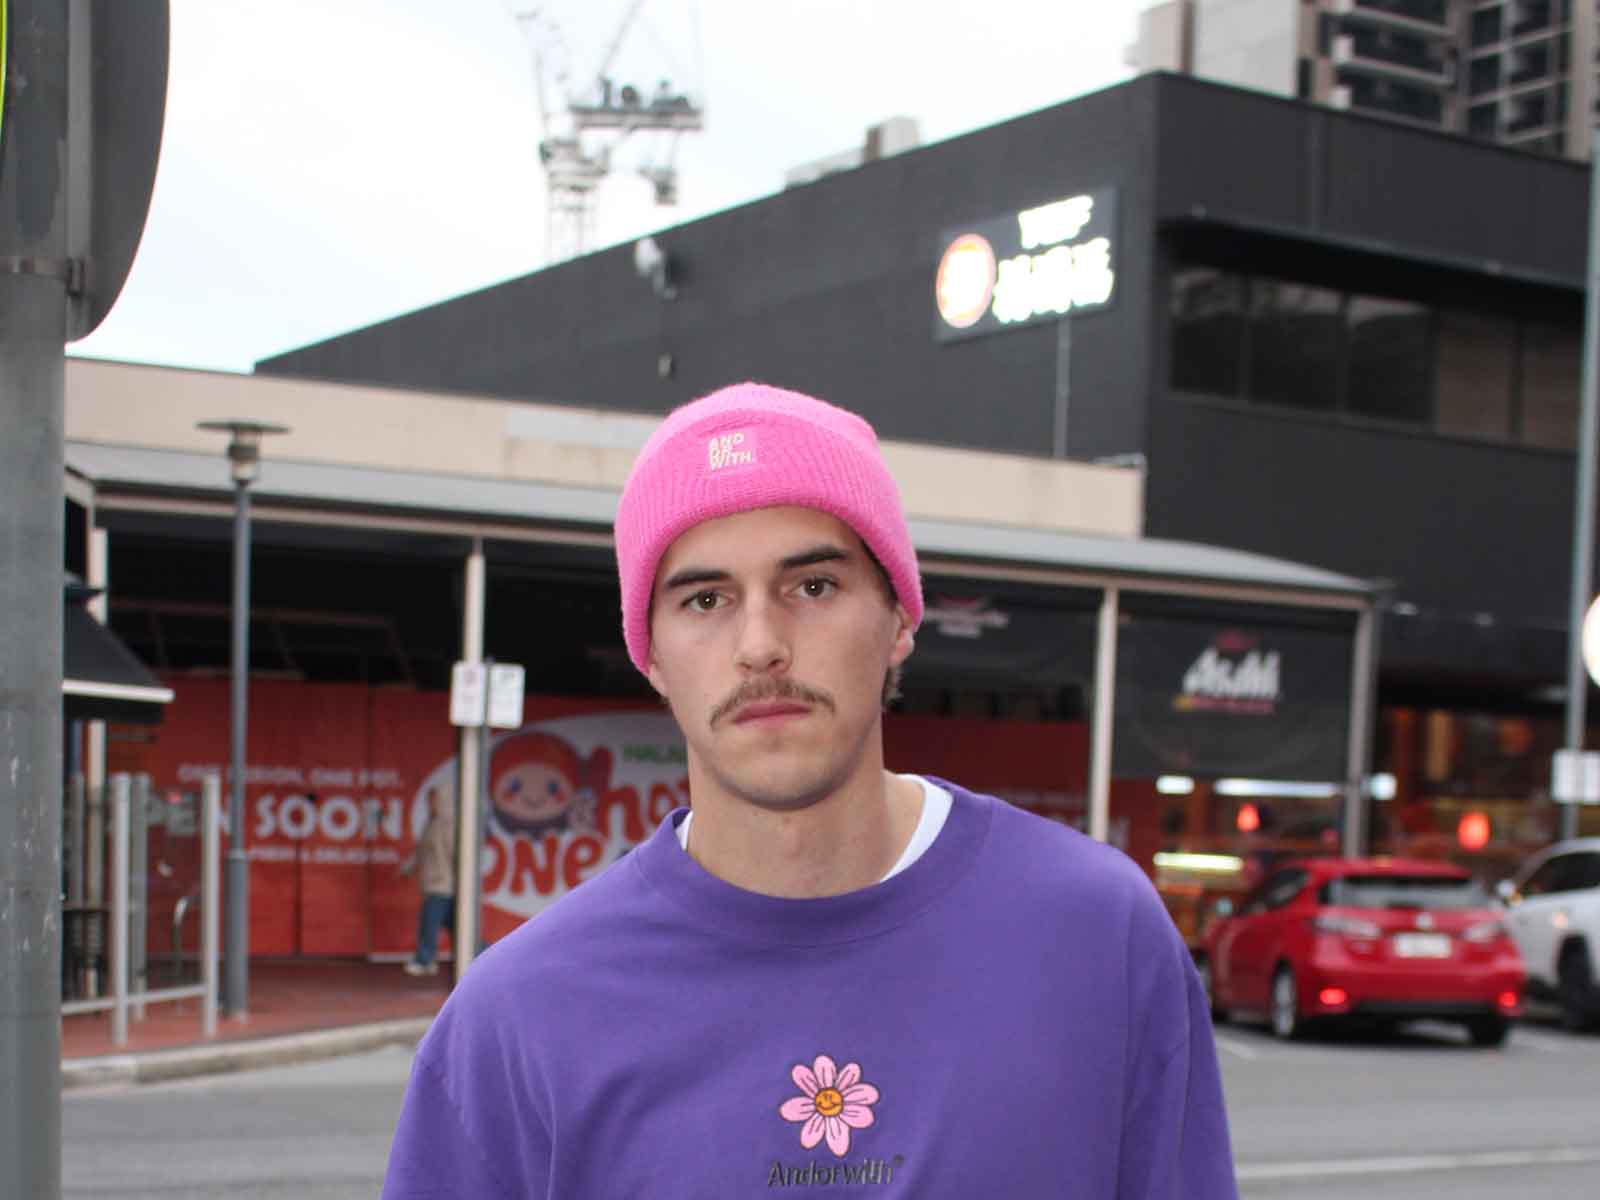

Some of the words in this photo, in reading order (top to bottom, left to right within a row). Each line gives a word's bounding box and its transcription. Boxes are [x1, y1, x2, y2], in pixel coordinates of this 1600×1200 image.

[709, 432, 745, 449] AND
[255, 794, 405, 841] SOON
[596, 745, 691, 845] ho
